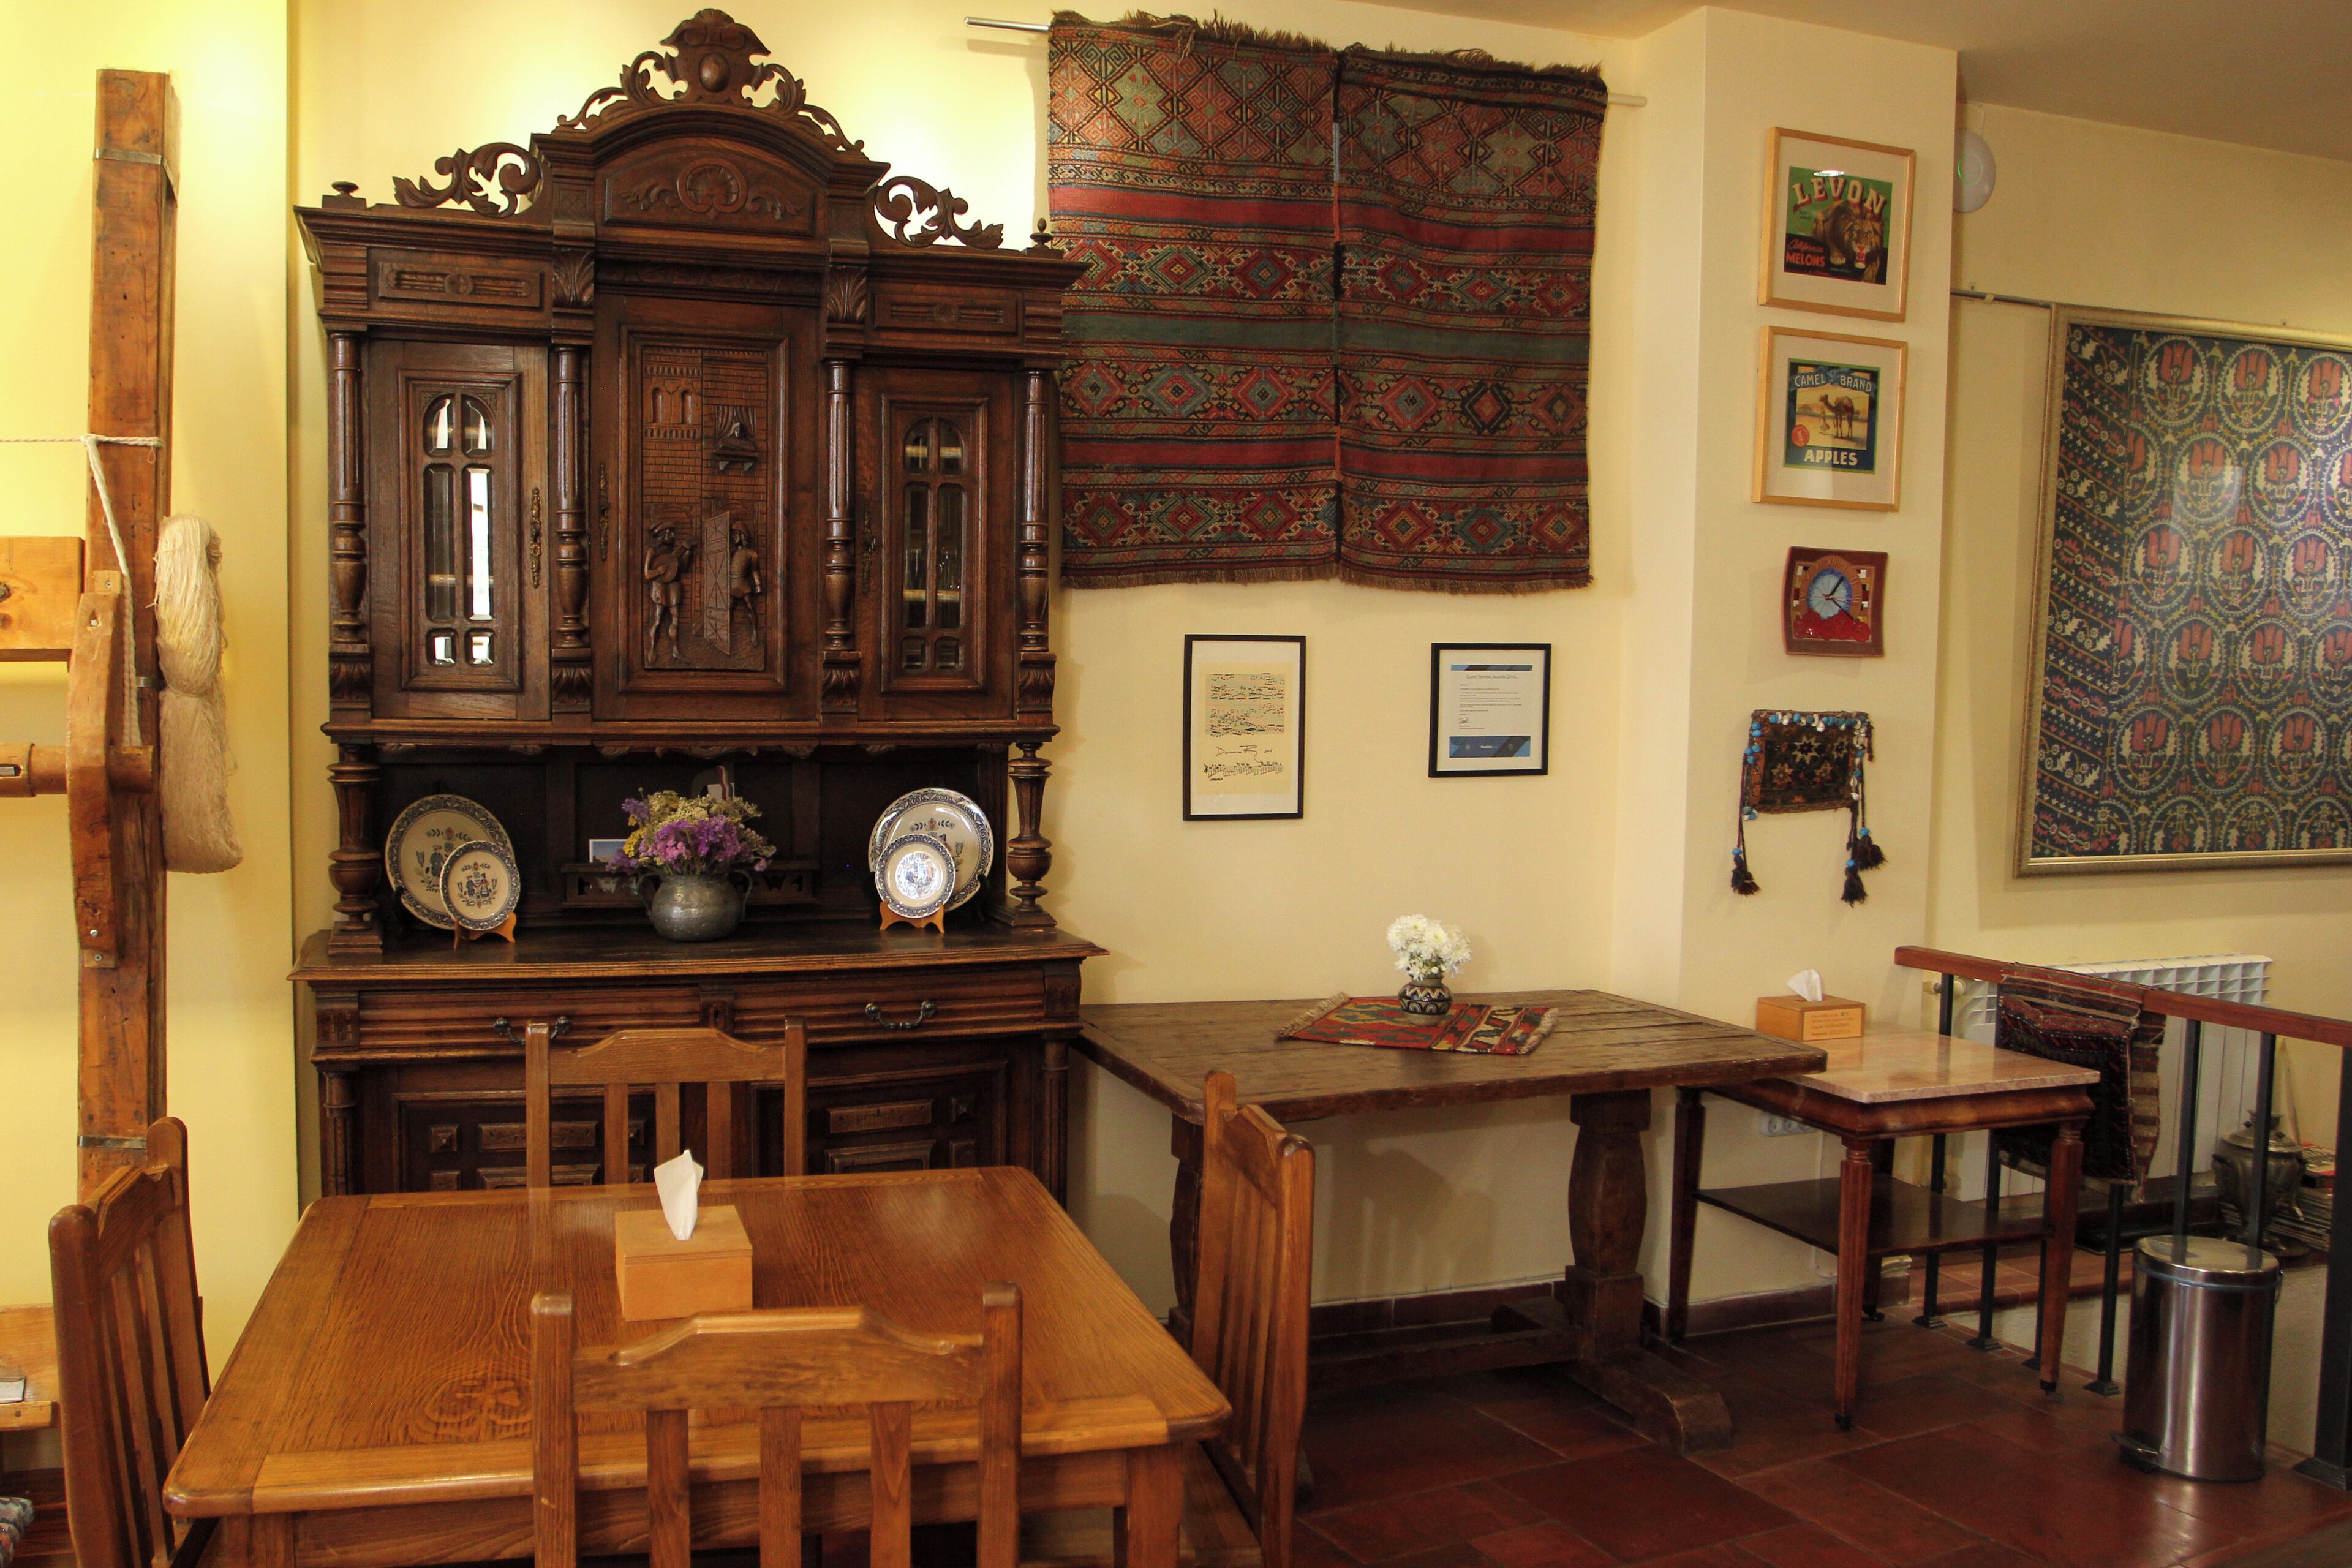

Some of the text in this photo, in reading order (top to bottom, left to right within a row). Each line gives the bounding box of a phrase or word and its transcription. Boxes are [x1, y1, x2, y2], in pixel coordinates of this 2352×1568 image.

[1792, 176, 1888, 216] LEVON
[1785, 252, 1825, 267] MELONS
[1795, 374, 1872, 392] CAMEL BRAND
[1804, 448, 1858, 466] APPLES
